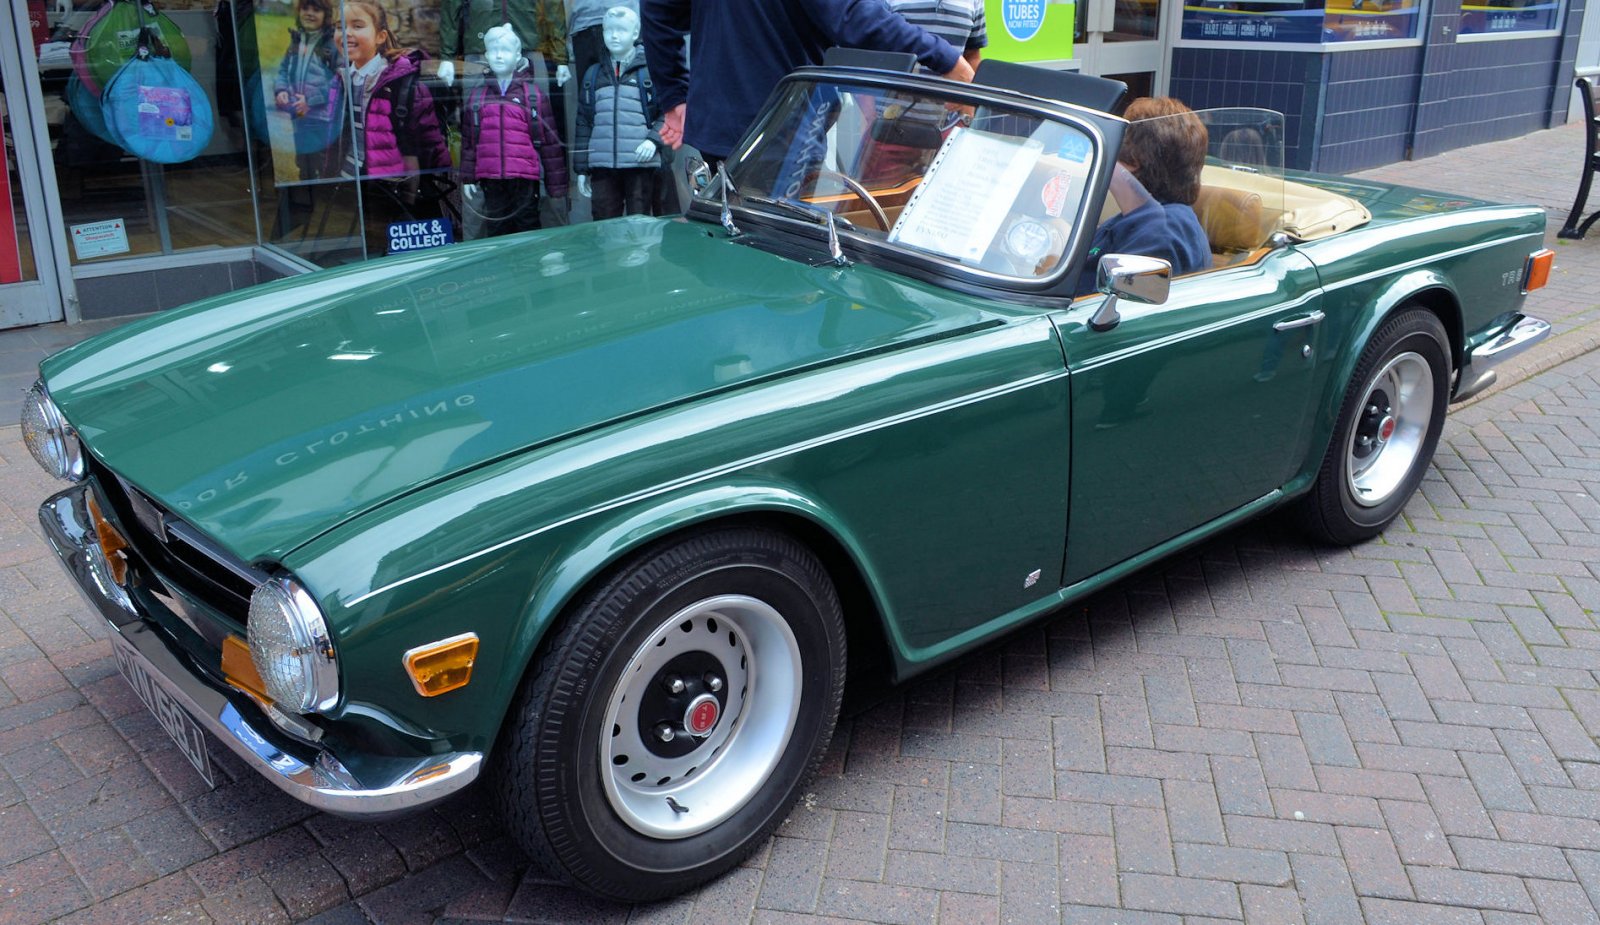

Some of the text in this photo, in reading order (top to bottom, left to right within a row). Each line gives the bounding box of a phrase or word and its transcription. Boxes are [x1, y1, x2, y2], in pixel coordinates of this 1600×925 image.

[1008, 4, 1039, 20] TUBES
[389, 219, 443, 238] CLICK &
[390, 232, 448, 251] COLLECT
